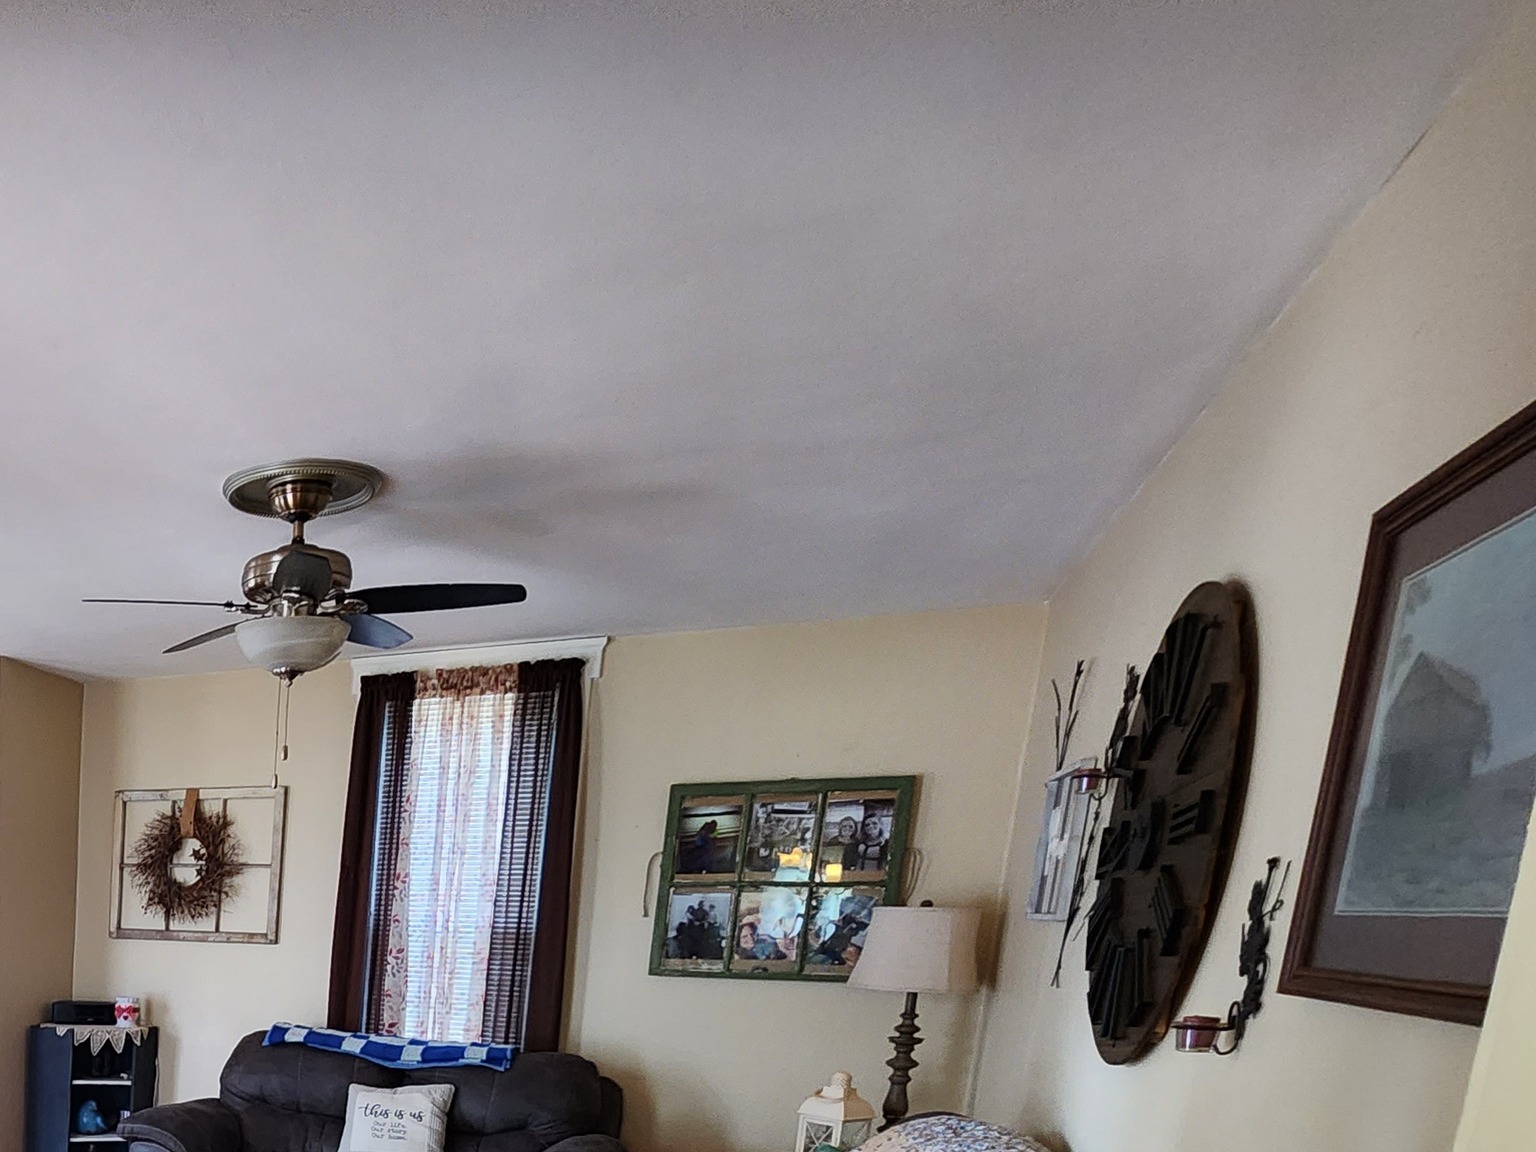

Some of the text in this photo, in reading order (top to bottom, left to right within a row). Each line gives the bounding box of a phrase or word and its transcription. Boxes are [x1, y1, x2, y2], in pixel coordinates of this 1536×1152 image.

[358, 1103, 425, 1122] this is us
